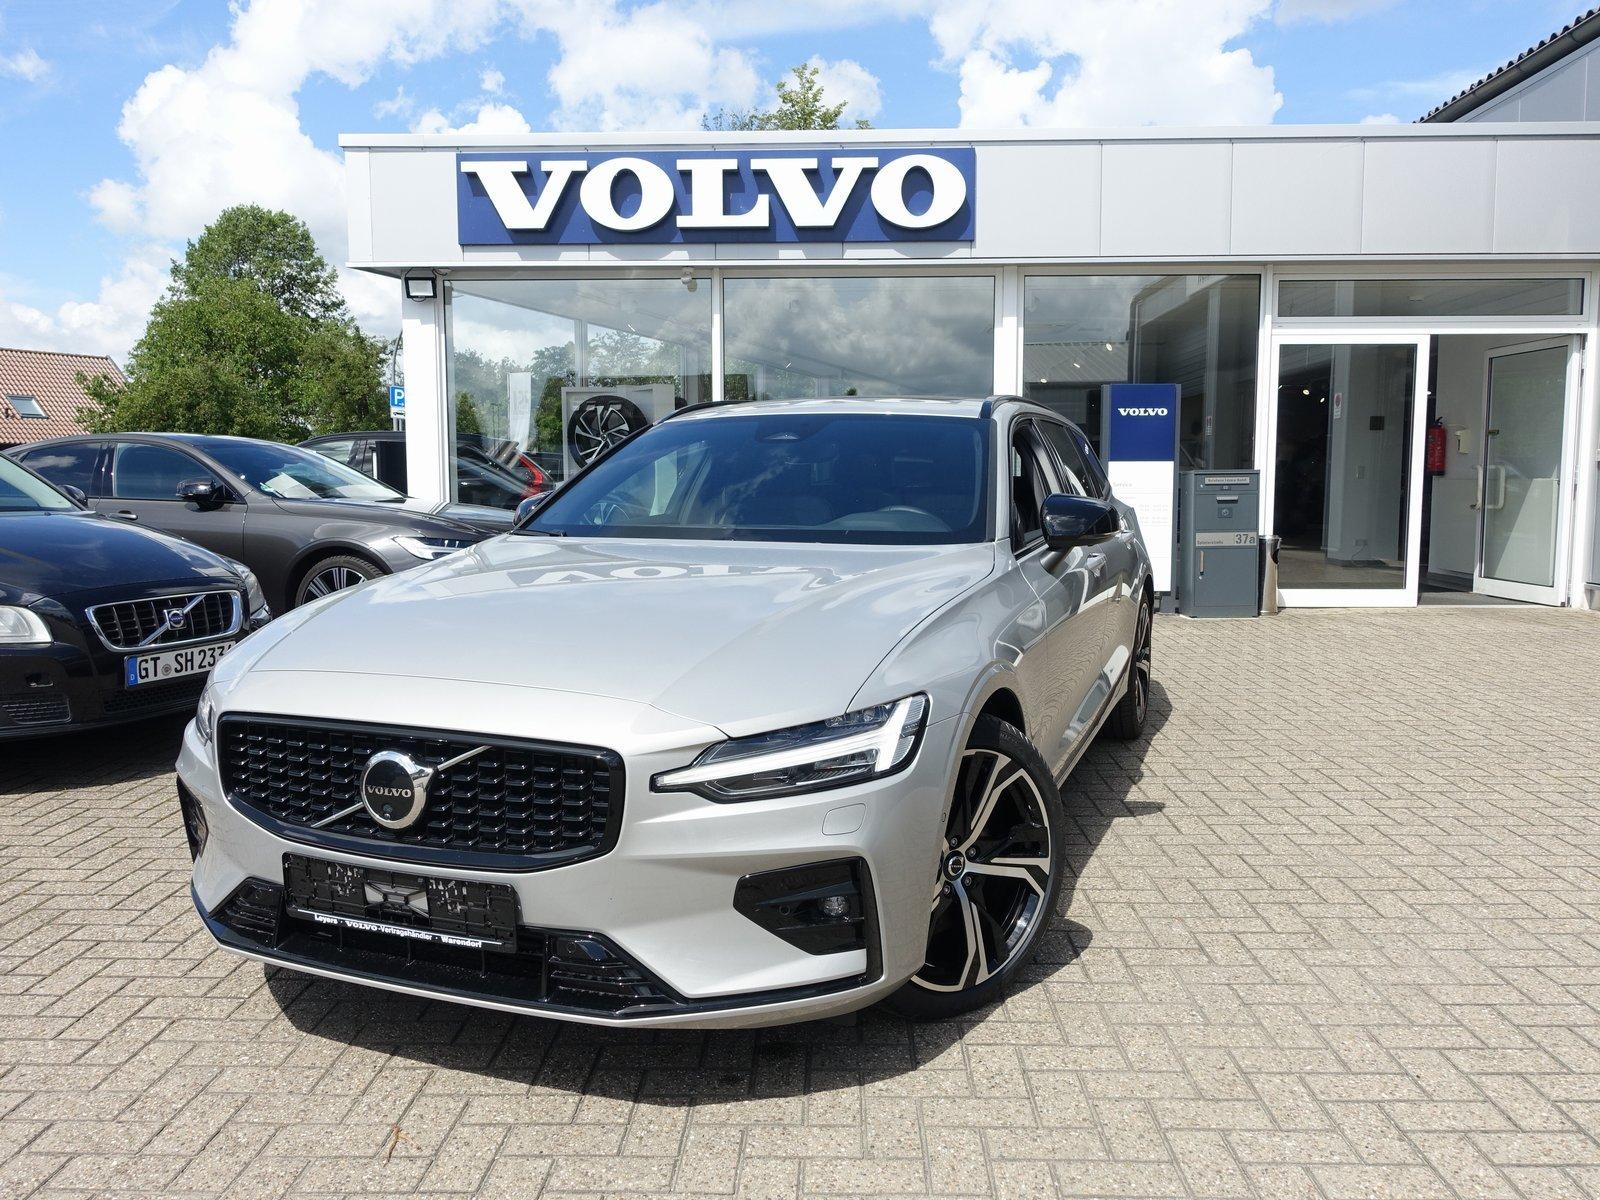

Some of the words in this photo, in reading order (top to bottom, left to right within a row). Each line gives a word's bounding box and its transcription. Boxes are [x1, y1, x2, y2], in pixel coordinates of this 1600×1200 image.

[460, 154, 967, 230] VOLVO
[394, 389, 405, 402] P
[1117, 407, 1168, 416] VOLVO
[1235, 533, 1256, 544] 37a
[138, 656, 161, 680] GT
[174, 650, 194, 674] SH
[198, 644, 232, 669] 233
[366, 784, 412, 798] VOLVO
[441, 935, 482, 948] Warendorf
